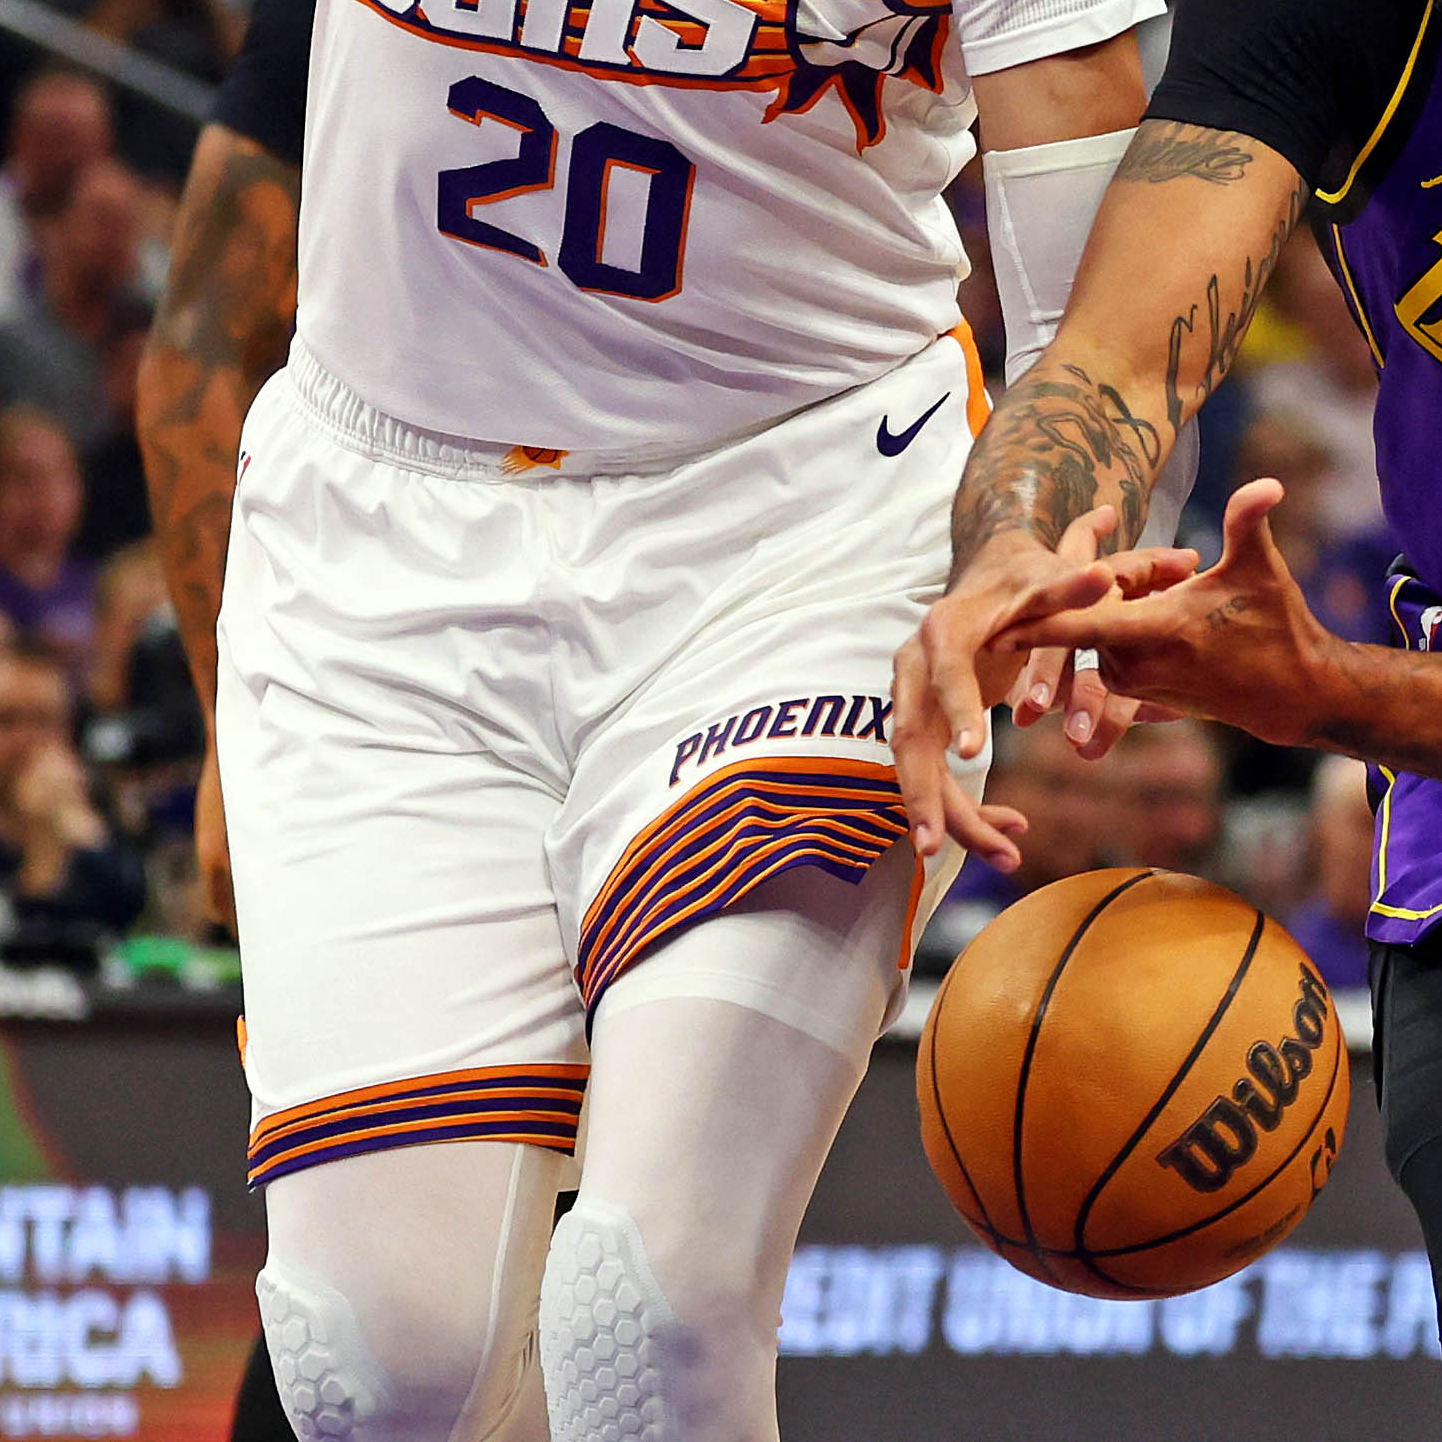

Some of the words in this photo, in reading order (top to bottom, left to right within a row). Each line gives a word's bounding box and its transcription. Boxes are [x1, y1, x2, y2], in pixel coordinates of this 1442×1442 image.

[437, 74, 697, 304] 20
[668, 694, 895, 789] PHOENIX
[1155, 961, 1328, 1193] Wilson
